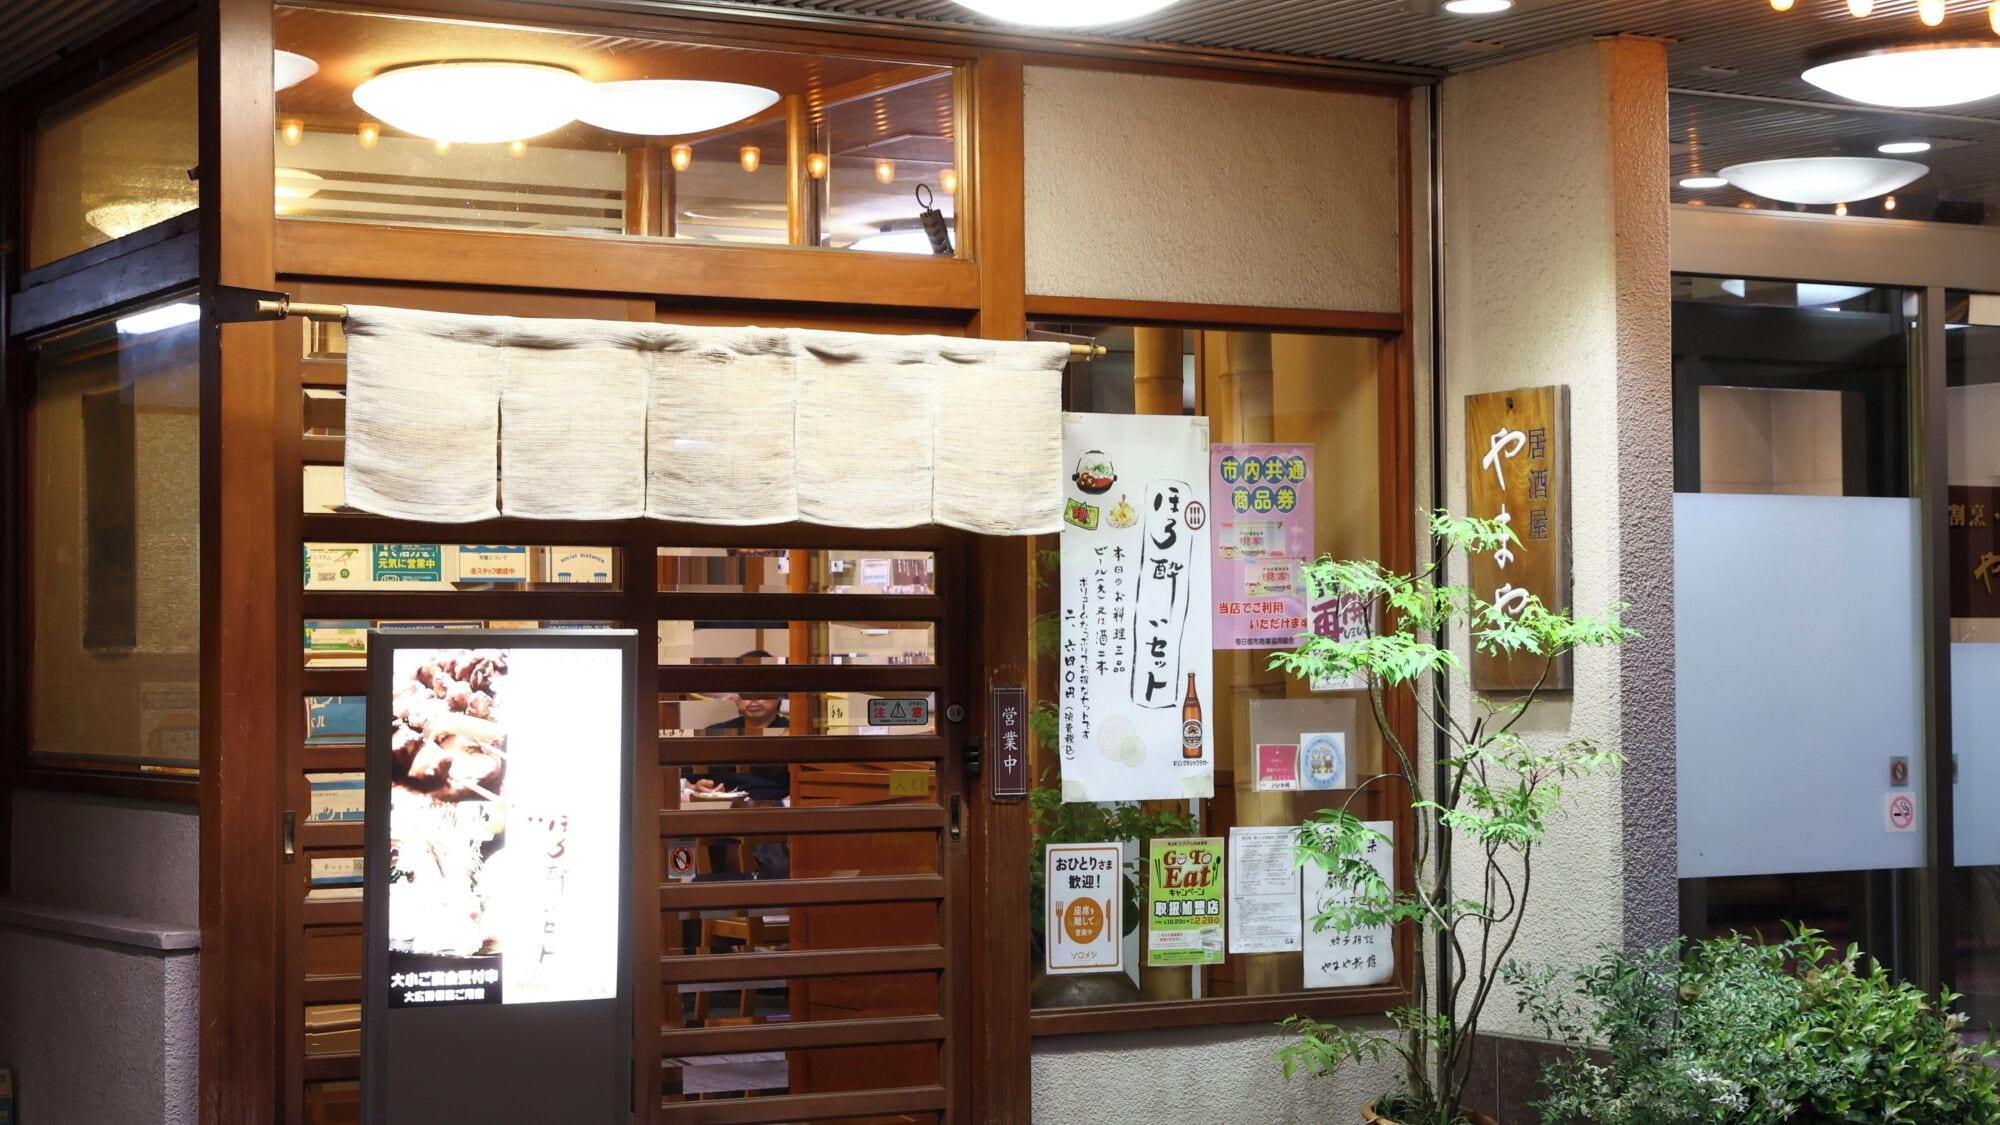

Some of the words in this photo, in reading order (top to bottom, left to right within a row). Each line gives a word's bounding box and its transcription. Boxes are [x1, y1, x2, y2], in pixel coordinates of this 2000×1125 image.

[1223, 460, 1306, 481] 市内共通
[1527, 427, 1549, 541] 居酒屋
[1233, 488, 1297, 511] 商品券
[1482, 427, 1530, 618] やまや
[378, 558, 436, 569] 元気に営業中
[1145, 487, 1184, 702] ほろ酔いセット
[1112, 546, 1126, 673] 本日のお料理三品
[1219, 602, 1284, 614] 当店でご利用
[1249, 618, 1307, 630] いただけます
[1002, 707, 1018, 776] 営業中
[896, 778, 924, 792] 入口
[1056, 856, 1113, 872] おひとりさま
[1068, 874, 1101, 889] 歓迎！
[1163, 865, 1211, 889] Eat
[1169, 889, 1205, 897] キャンペーン
